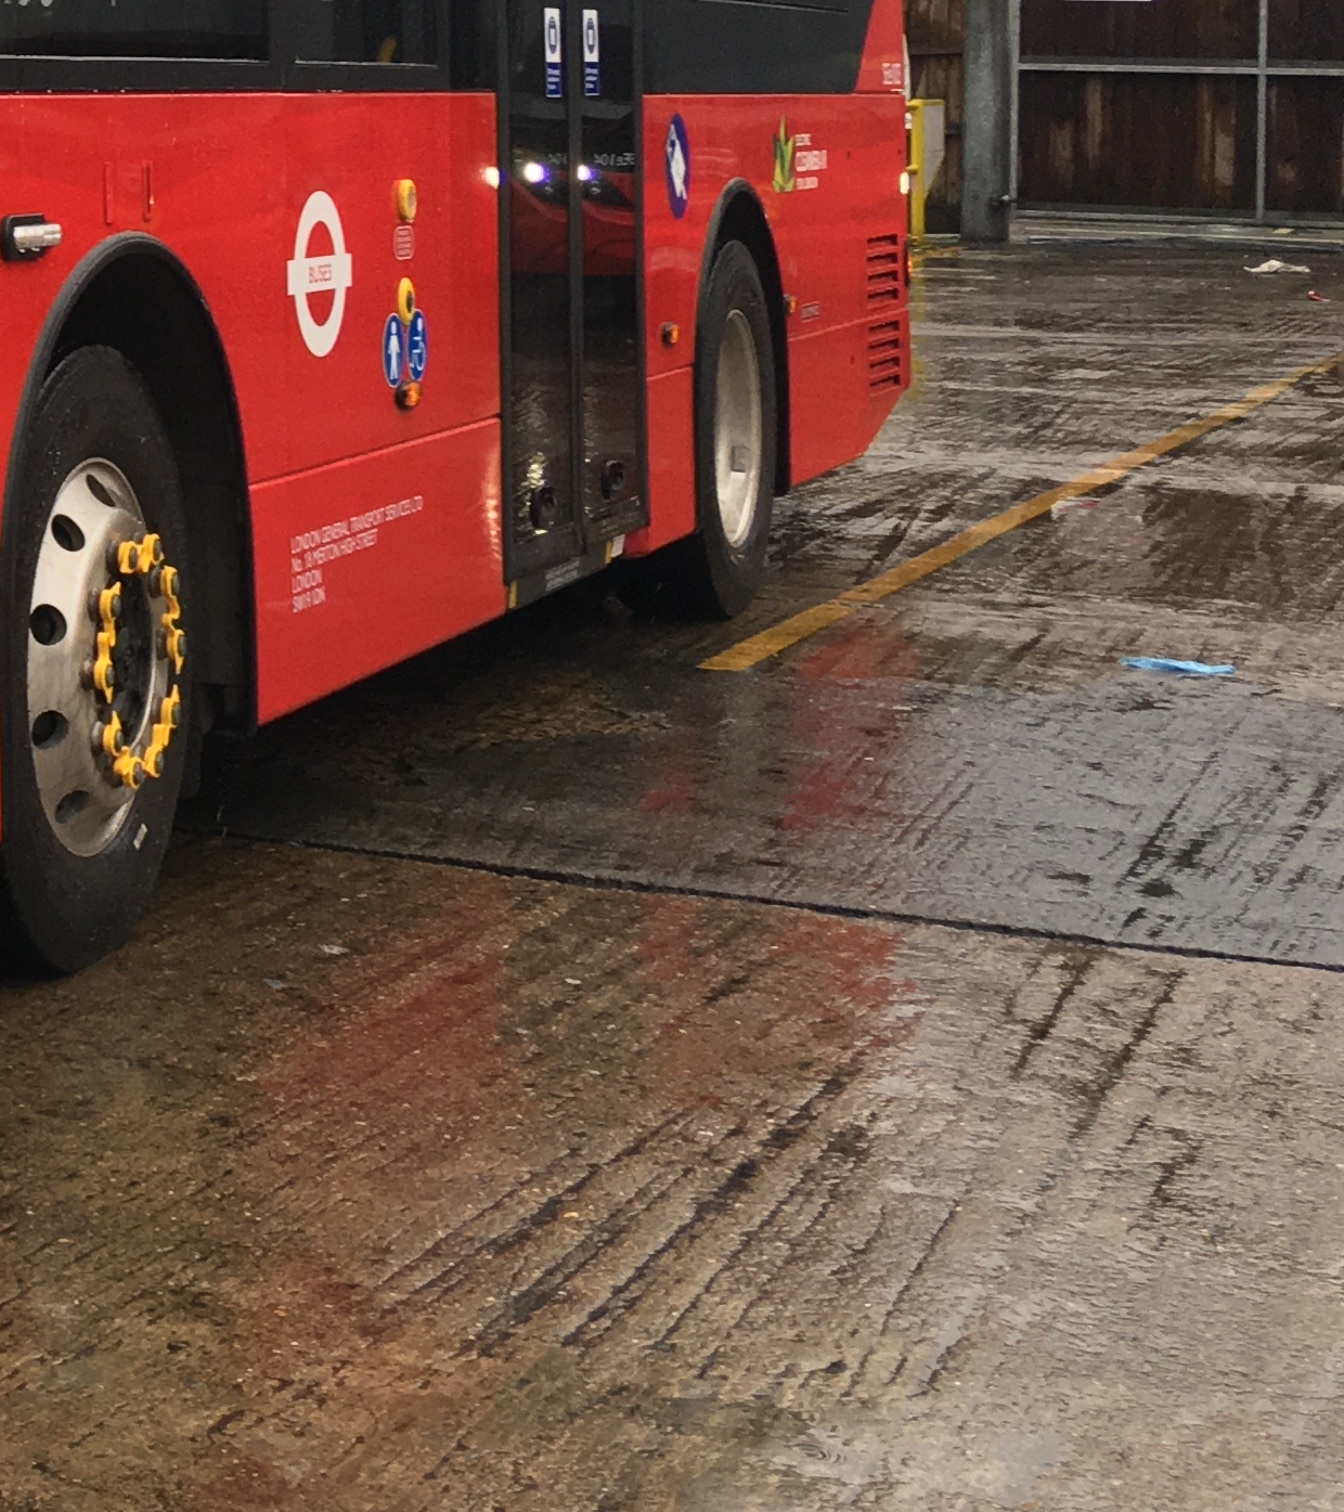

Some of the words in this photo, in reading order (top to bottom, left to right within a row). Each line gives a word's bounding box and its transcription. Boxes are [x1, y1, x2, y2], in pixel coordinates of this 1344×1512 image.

[308, 264, 332, 284] BUSES
[290, 530, 321, 554] LONDON
[292, 568, 322, 593] LONDON
